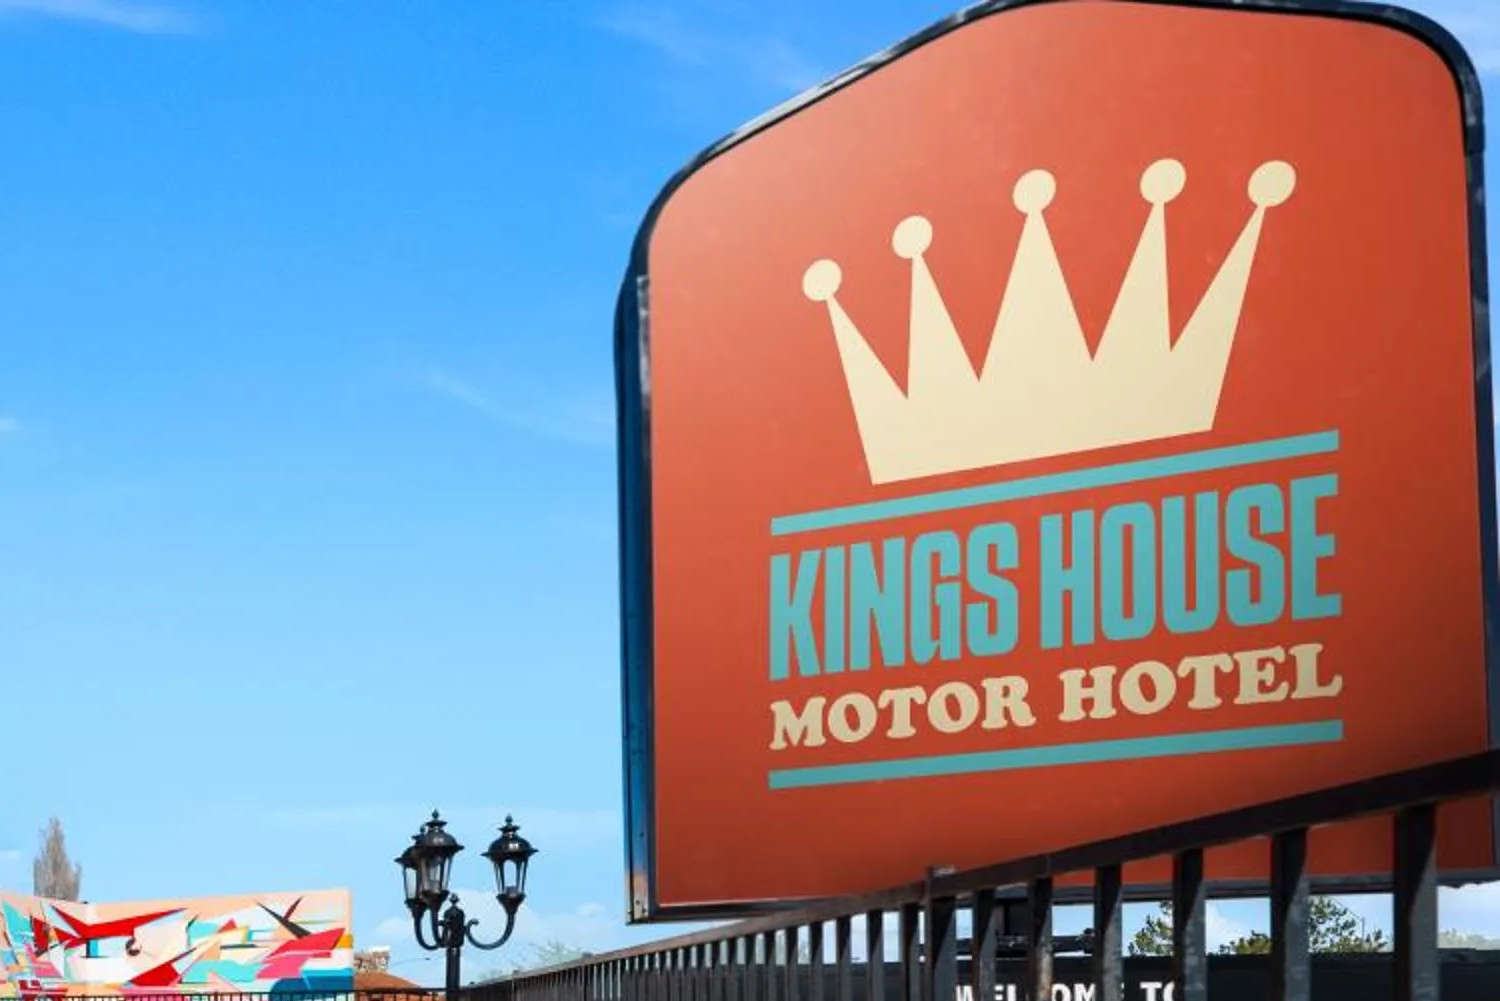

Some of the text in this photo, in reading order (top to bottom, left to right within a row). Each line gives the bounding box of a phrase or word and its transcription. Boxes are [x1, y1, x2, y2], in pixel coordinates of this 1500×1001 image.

[770, 473, 1341, 681] KINGS HOUSE
[769, 643, 1342, 750] MOTOR HOTEL
